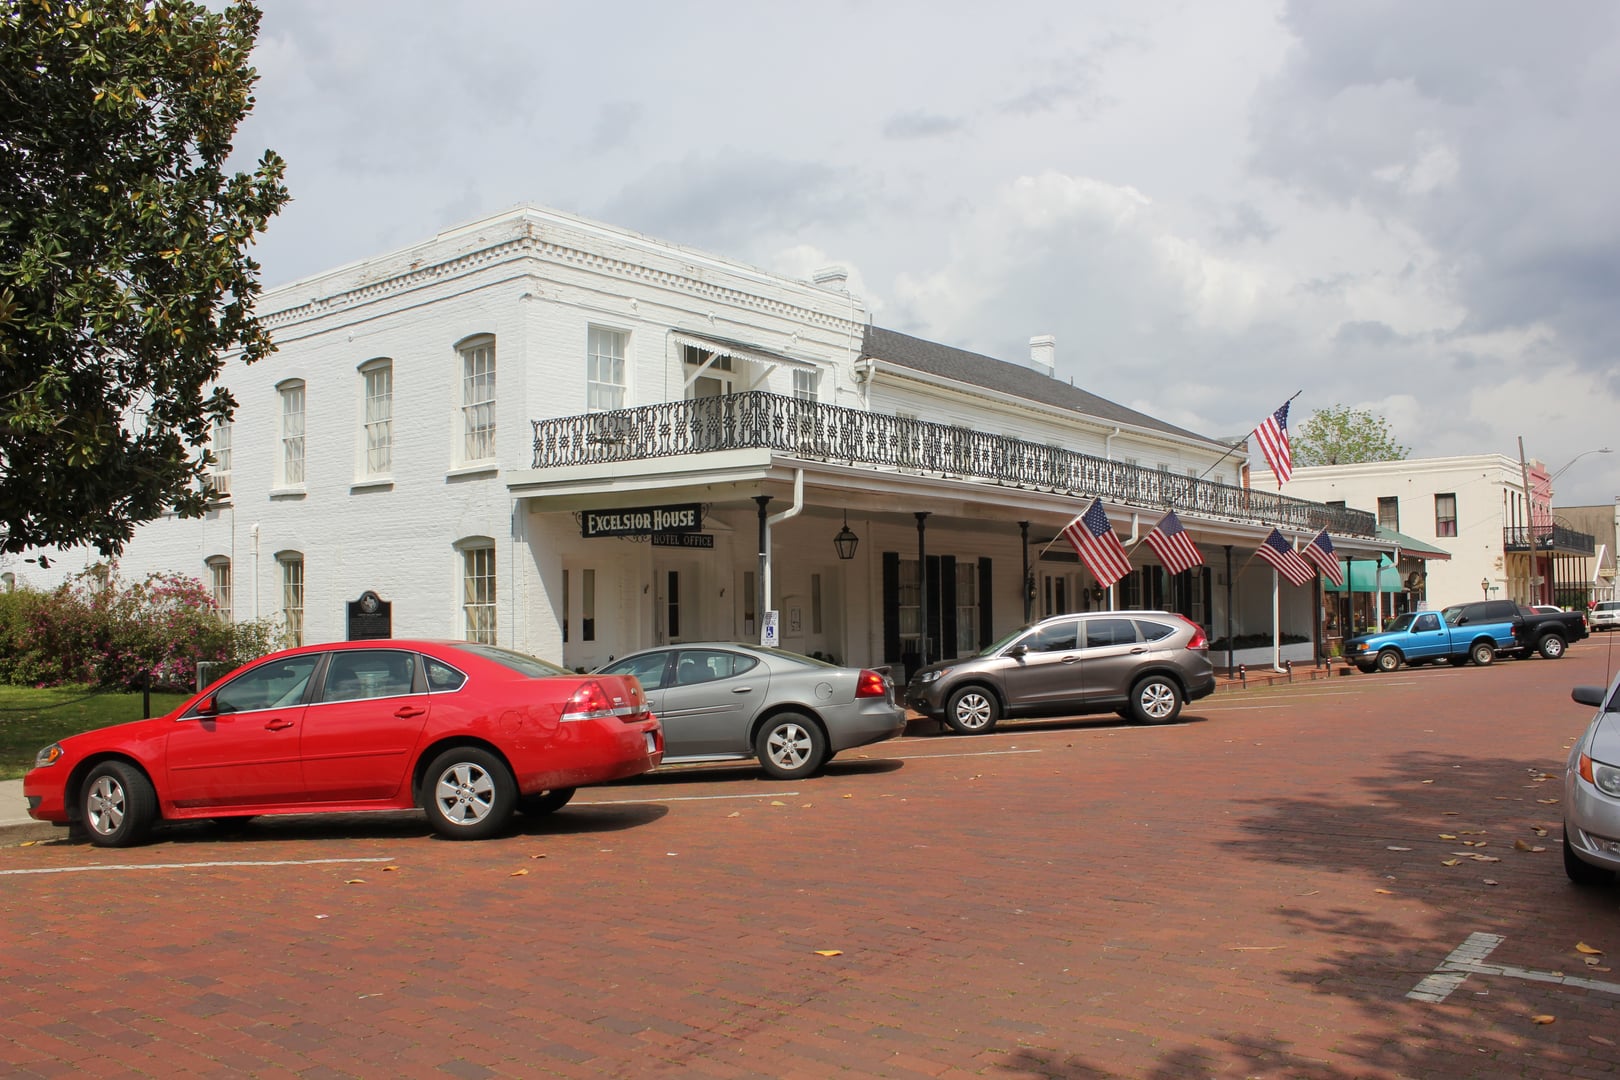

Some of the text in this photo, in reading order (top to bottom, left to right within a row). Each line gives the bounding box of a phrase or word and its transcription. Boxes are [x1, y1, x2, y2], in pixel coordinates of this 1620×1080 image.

[588, 510, 695, 534] EXCELSIOR HOUSE
[653, 534, 712, 546] HOTEL OFFICE
